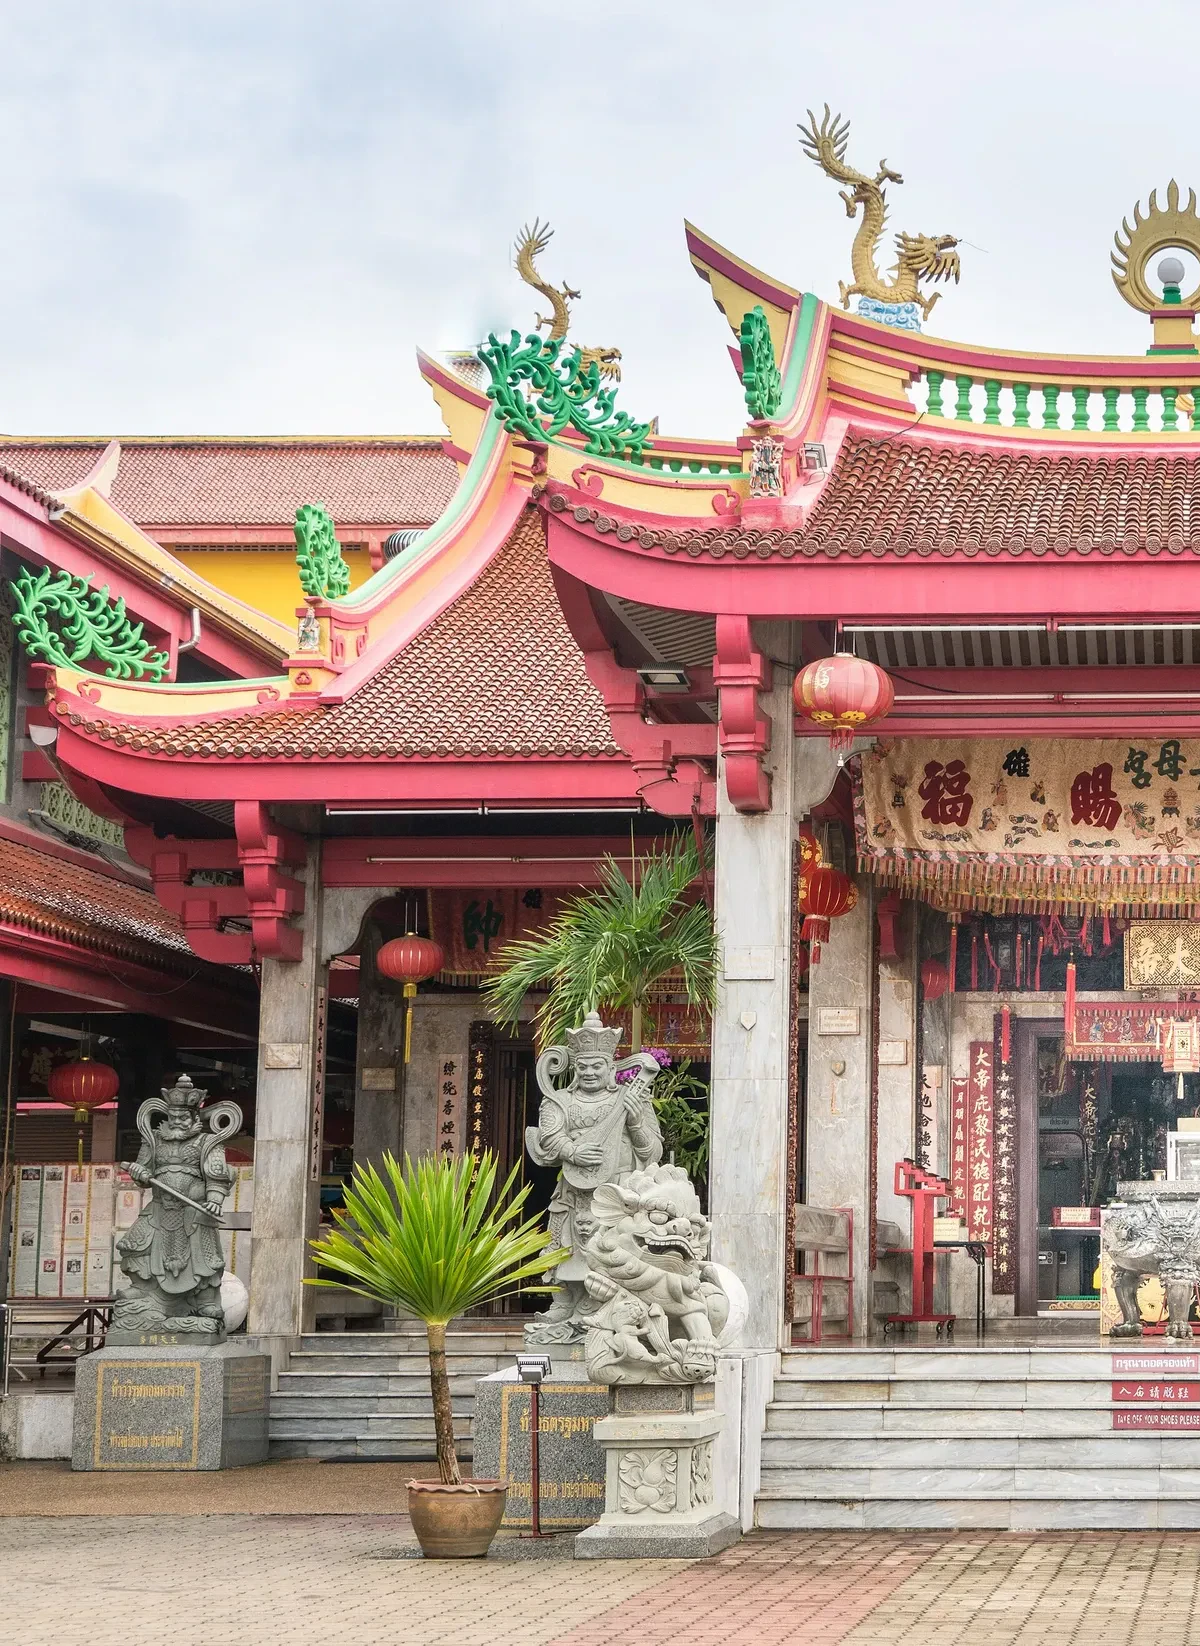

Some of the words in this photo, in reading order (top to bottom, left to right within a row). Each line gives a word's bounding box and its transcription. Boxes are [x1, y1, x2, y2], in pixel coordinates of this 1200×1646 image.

[1116, 1356, 1195, 1370] กรุณาถอดรองเท้า
[1160, 1415, 1178, 1425] SHOES
[1180, 1415, 1200, 1425] PLEASE
